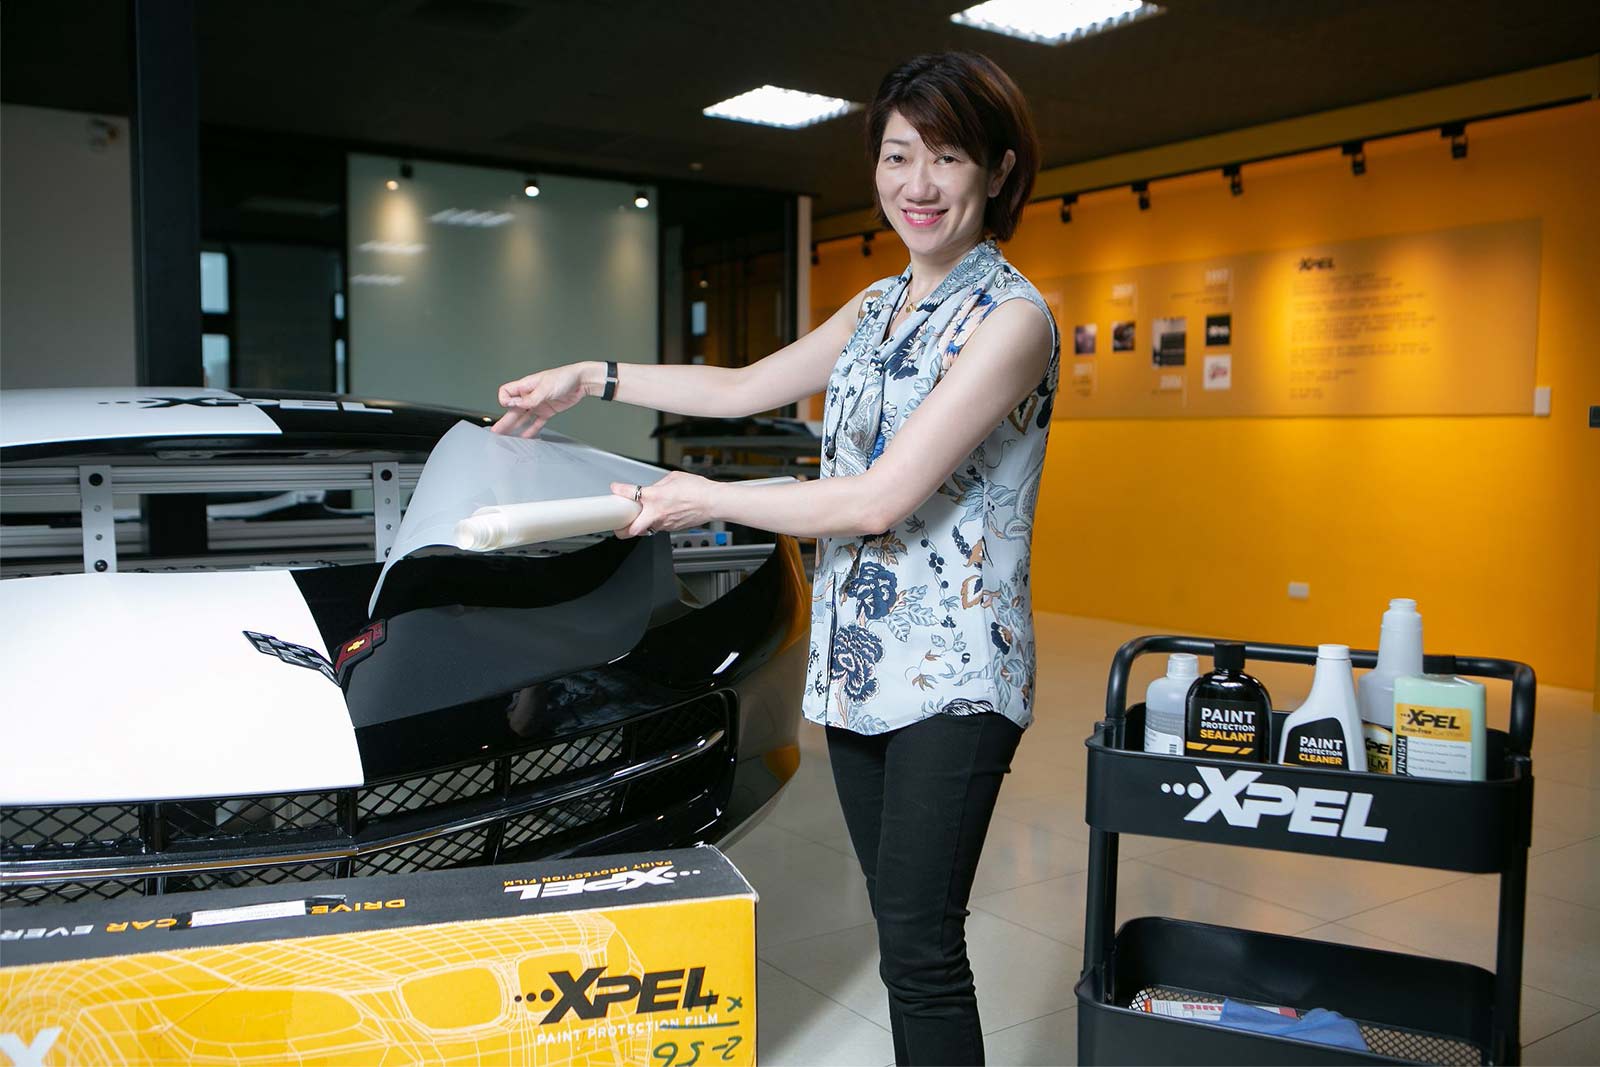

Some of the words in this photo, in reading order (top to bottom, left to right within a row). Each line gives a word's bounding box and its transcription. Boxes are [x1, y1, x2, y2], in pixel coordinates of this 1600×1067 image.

[1201, 707, 1256, 724] PAINT
[1406, 708, 1461, 730] XPEL
[1201, 721, 1256, 732] PROTECTION
[1200, 729, 1256, 743] SEALANT
[1299, 735, 1344, 751] PAINT
[1298, 752, 1343, 766] CLEANER
[1299, 746, 1343, 757] PROTECTION
[1397, 738, 1406, 775] FINISH
[1183, 765, 1389, 843] XPEL
[632, 860, 673, 870] PAINT
[502, 877, 538, 887] FILM
[503, 864, 674, 900] XPEL
[541, 865, 628, 883] PROTECTION
[311, 898, 406, 915] DRIVE
[105, 917, 177, 933] CAR
[539, 966, 720, 1026] XPEL
[537, 1029, 581, 1046] PAINT
[587, 1017, 680, 1039] PROTECTION
[685, 1012, 719, 1028] FILM
